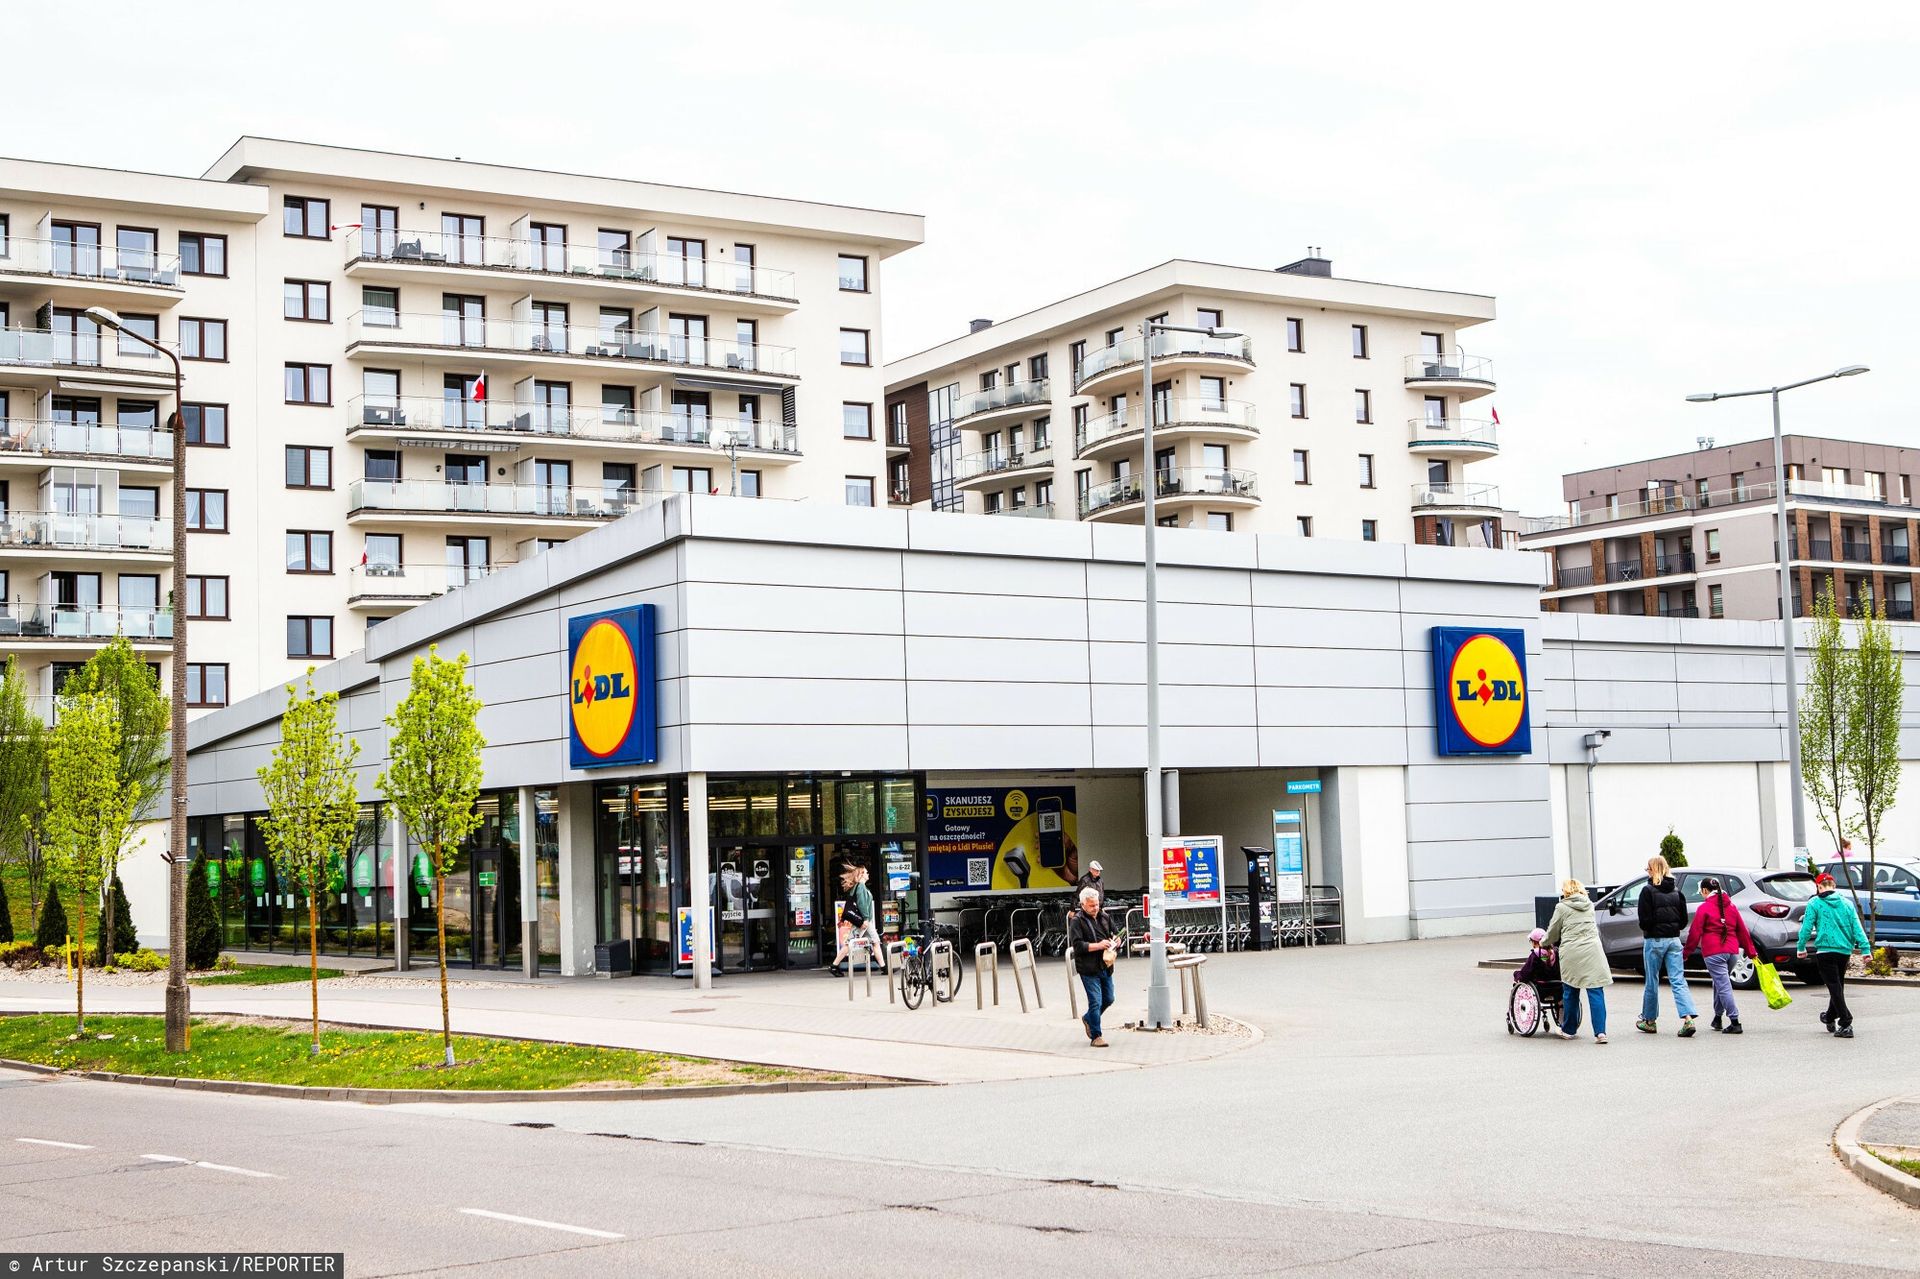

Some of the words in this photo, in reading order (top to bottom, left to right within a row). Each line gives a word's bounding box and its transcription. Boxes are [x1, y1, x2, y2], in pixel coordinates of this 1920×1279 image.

[945, 796, 992, 805] SKANUJESZ
[945, 806, 993, 816] ZYSKUJESZ
[945, 825, 970, 833] Gotowy
[939, 832, 986, 842] oszczędności?
[928, 842, 952, 853] amiętaj
[957, 842, 971, 851] Lidl
[971, 841, 994, 851] Plusie!
[796, 864, 804, 872] 52
[1164, 878, 1185, 891] 25%
